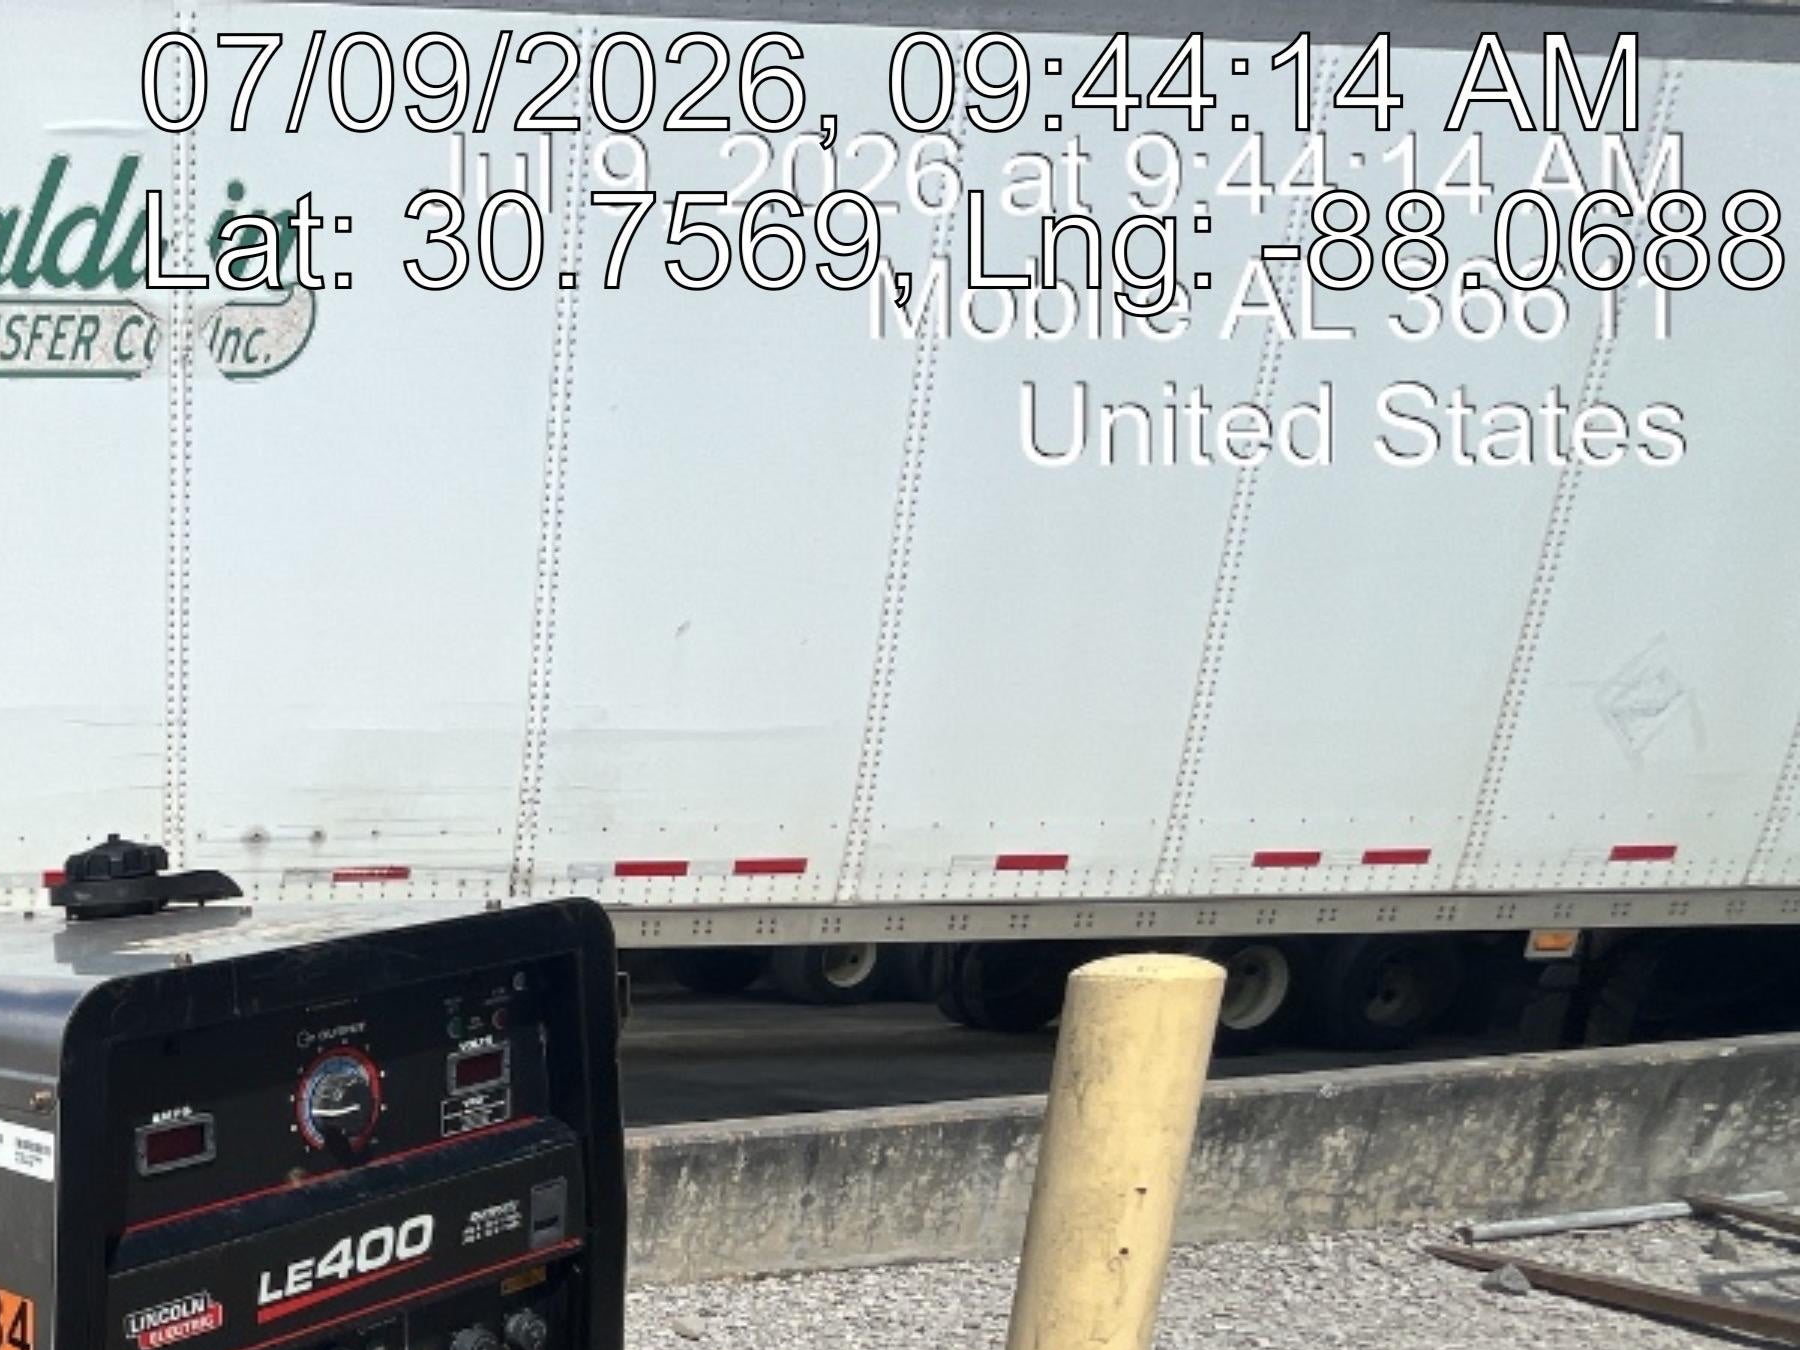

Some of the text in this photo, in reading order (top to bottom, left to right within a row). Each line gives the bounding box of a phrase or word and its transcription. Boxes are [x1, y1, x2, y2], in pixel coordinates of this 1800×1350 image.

[208, 314, 273, 364] Inc.
[256, 1213, 435, 1306] LE400
[130, 1296, 207, 1334] LINCOLN
[150, 1312, 215, 1348] ELECTRIC
